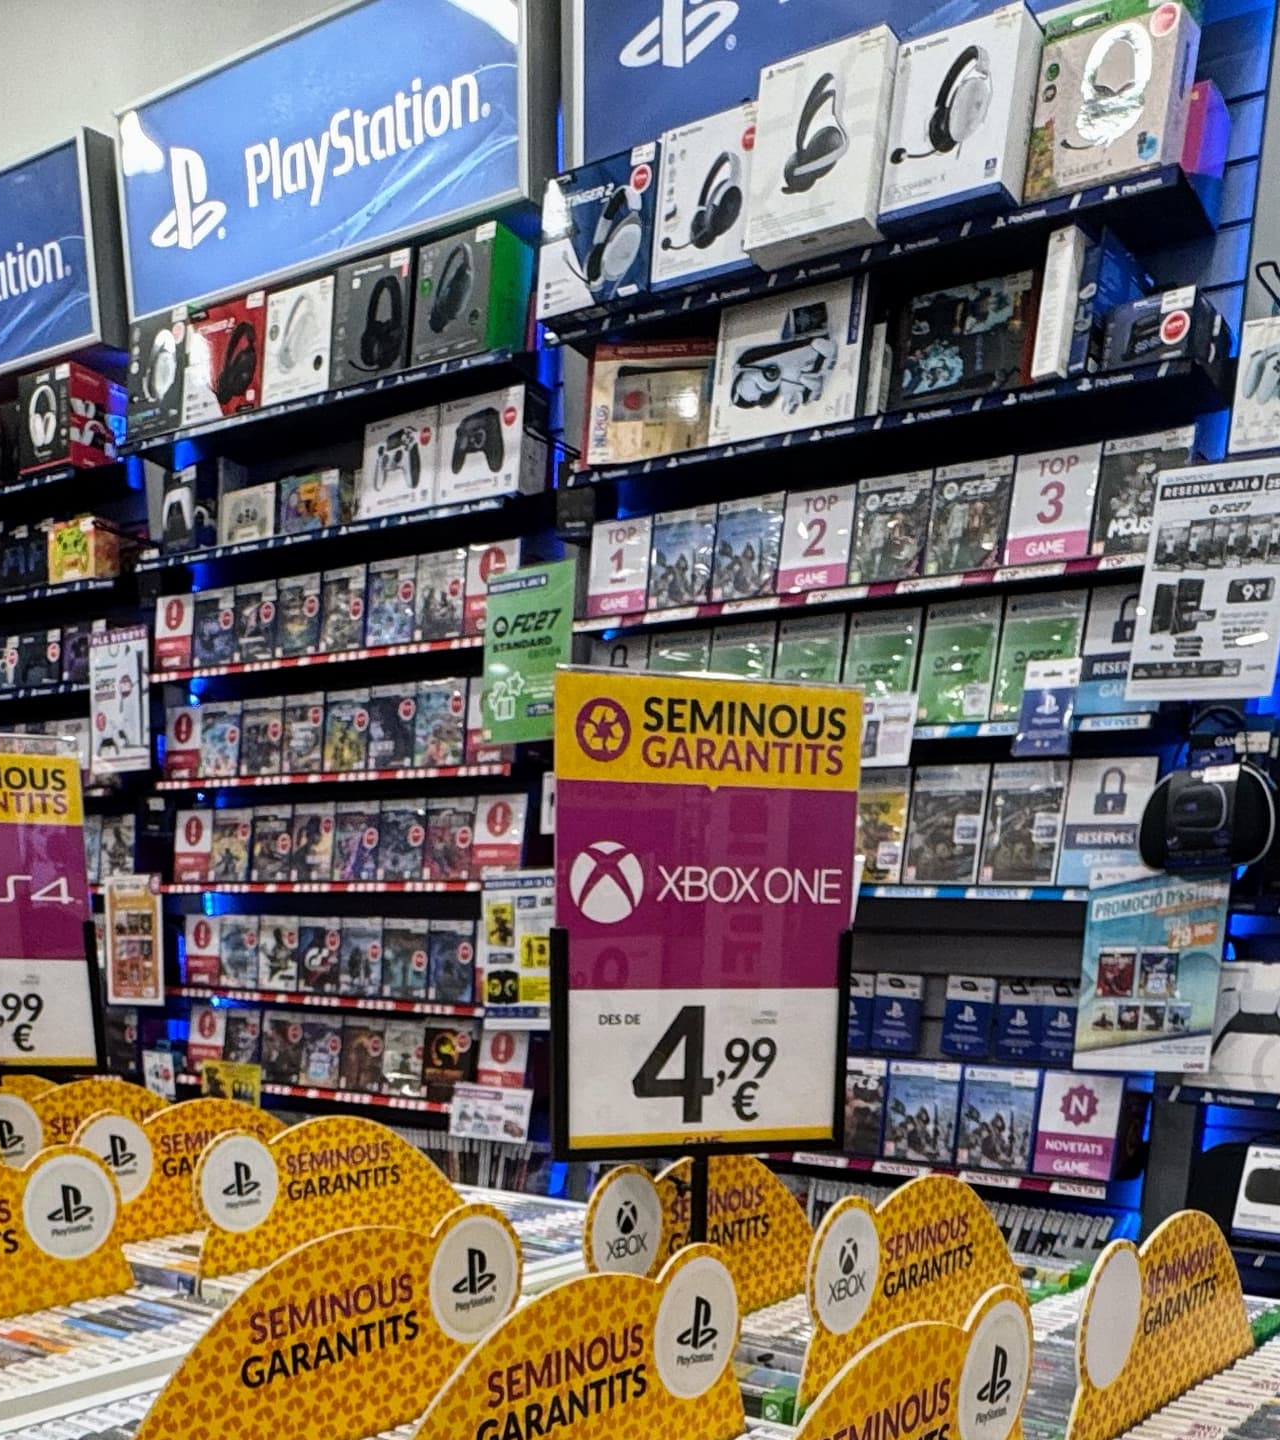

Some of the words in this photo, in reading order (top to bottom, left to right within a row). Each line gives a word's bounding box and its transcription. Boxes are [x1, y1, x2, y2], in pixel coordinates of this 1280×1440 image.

[246, 72, 481, 207] PlayStation
[1037, 454, 1081, 478] TOP
[803, 494, 840, 515] TOP
[1037, 480, 1066, 525] 3
[607, 525, 638, 545] TOP
[802, 518, 826, 558] 2
[1023, 537, 1066, 557] GAME
[795, 570, 827, 589] GAME
[601, 594, 630, 612] GAME
[642, 695, 847, 741] SEMINOUS
[641, 735, 844, 777] GARANTITS
[1075, 831, 1134, 845] RESERVES
[656, 865, 759, 903] XBOX
[761, 867, 842, 905] ONE
[1094, 894, 1162, 919] PROMOCIÓ
[598, 1013, 622, 1026] DES
[625, 1013, 642, 1026] DE
[632, 1006, 778, 1125] 4,99
[732, 1082, 761, 1123] €
[284, 1139, 392, 1177] SEMINOUS
[1044, 1140, 1103, 1155] NOVETATS
[1052, 1158, 1089, 1174] GAME
[284, 1165, 402, 1202] GARANTITS
[606, 1232, 648, 1261] XBOX
[883, 1210, 970, 1264] SEMINOUS
[827, 1272, 866, 1303] XBOX
[882, 1241, 974, 1298] GARANTITS
[250, 1273, 413, 1346] SEMINOUS
[1142, 1274, 1218, 1336] GARANTITS
[239, 1310, 422, 1390] GARANTITS
[486, 1322, 645, 1407] SEMINOUS
[675, 1348, 716, 1369] PlayStation
